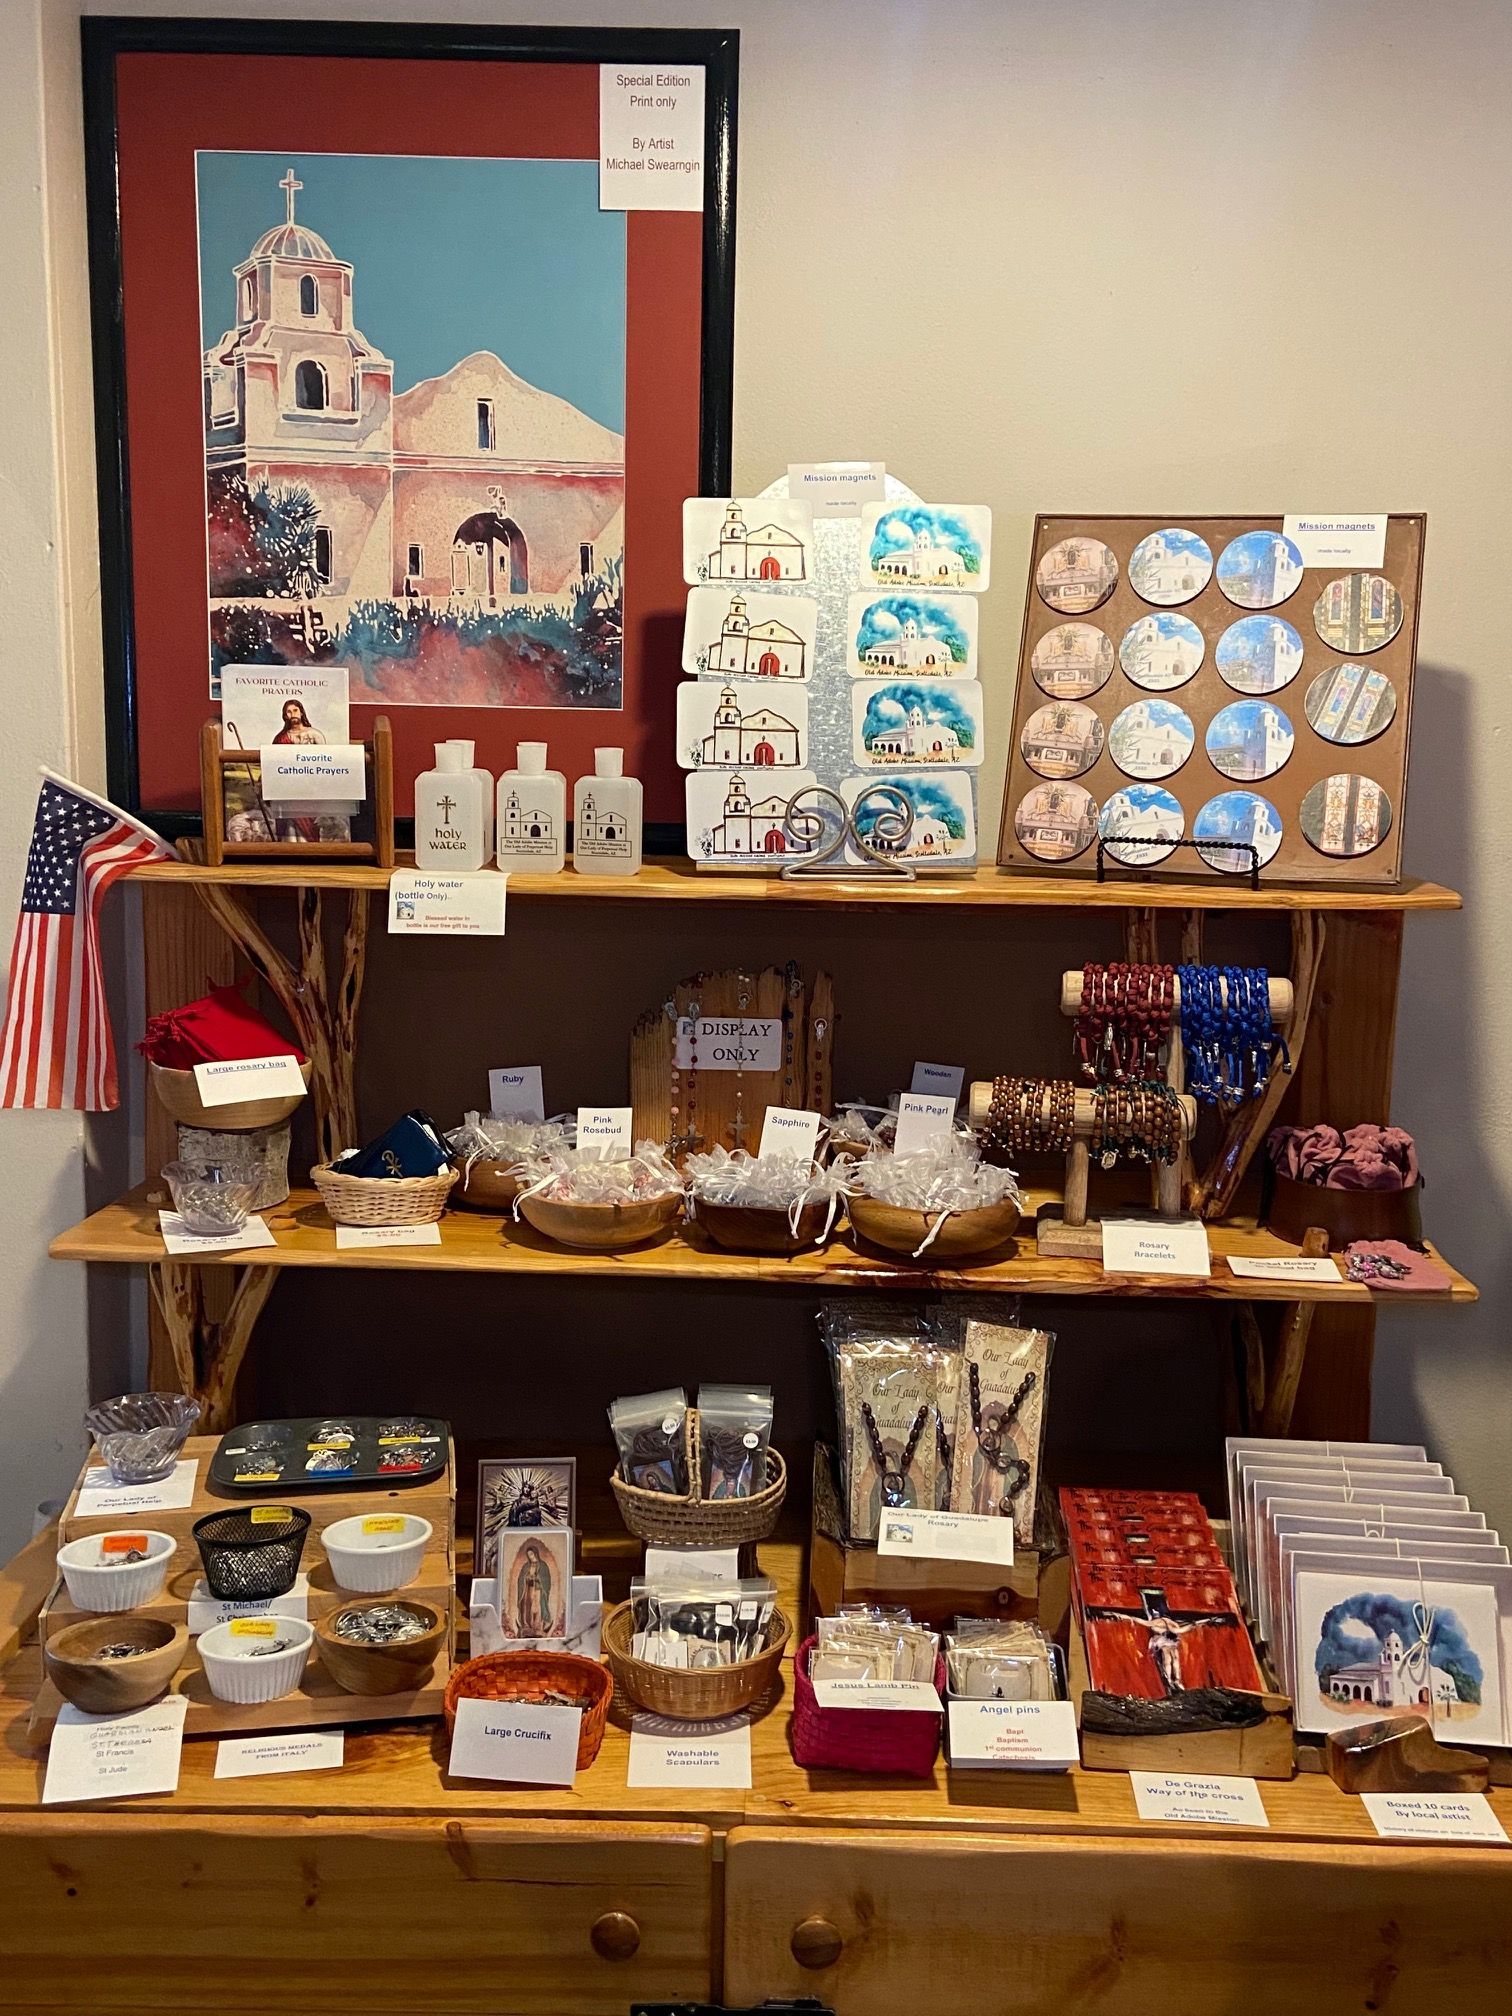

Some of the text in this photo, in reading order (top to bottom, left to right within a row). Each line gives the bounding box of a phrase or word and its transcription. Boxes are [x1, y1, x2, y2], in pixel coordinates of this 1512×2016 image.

[616, 74, 690, 88] Special Edition
[630, 95, 676, 109] Print only
[632, 138, 674, 152] By Artist
[606, 158, 700, 173] Michael Swearngin
[804, 474, 876, 484] Mission magnets
[1298, 522, 1376, 532] Mission magnets
[236, 678, 328, 687] FAVORITE CATHOLIC
[296, 754, 332, 762] Favorite
[277, 767, 349, 776] Catholic Prayers
[435, 828, 462, 840] holy
[430, 841, 467, 850] WATER
[414, 880, 435, 890] Holy
[395, 891, 425, 900] (bottle
[702, 1023, 772, 1037] DISPLAY
[713, 1048, 760, 1062] ONLY
[924, 1068, 952, 1078] Wooden
[502, 1075, 524, 1086] Ruby
[904, 1103, 949, 1115] Pink Pearl
[594, 1116, 612, 1124] Pink
[772, 1116, 810, 1129] Sapphire
[583, 1126, 622, 1134] Rosebud
[1139, 1242, 1170, 1251] Rosary
[1134, 1251, 1176, 1260] Bracelets
[983, 1348, 1028, 1369] Our Lady
[1000, 1369, 1010, 1380] of
[872, 1384, 919, 1400] Our Lady
[936, 1381, 954, 1394] Our
[891, 1401, 899, 1414] of
[928, 1520, 958, 1528] Rosary
[233, 1600, 272, 1609] Michael/
[216, 1615, 225, 1623] St
[980, 1706, 1040, 1715] Angel pins
[484, 1726, 551, 1740] Large Crucifix
[1184, 1782, 1221, 1790] Grazia
[1146, 1788, 1171, 1796] Way
[1211, 1793, 1244, 1801] cross
[1386, 1801, 1420, 1809] Boxed
[1440, 1803, 1469, 1811] cards
[1411, 1811, 1439, 1819] local
